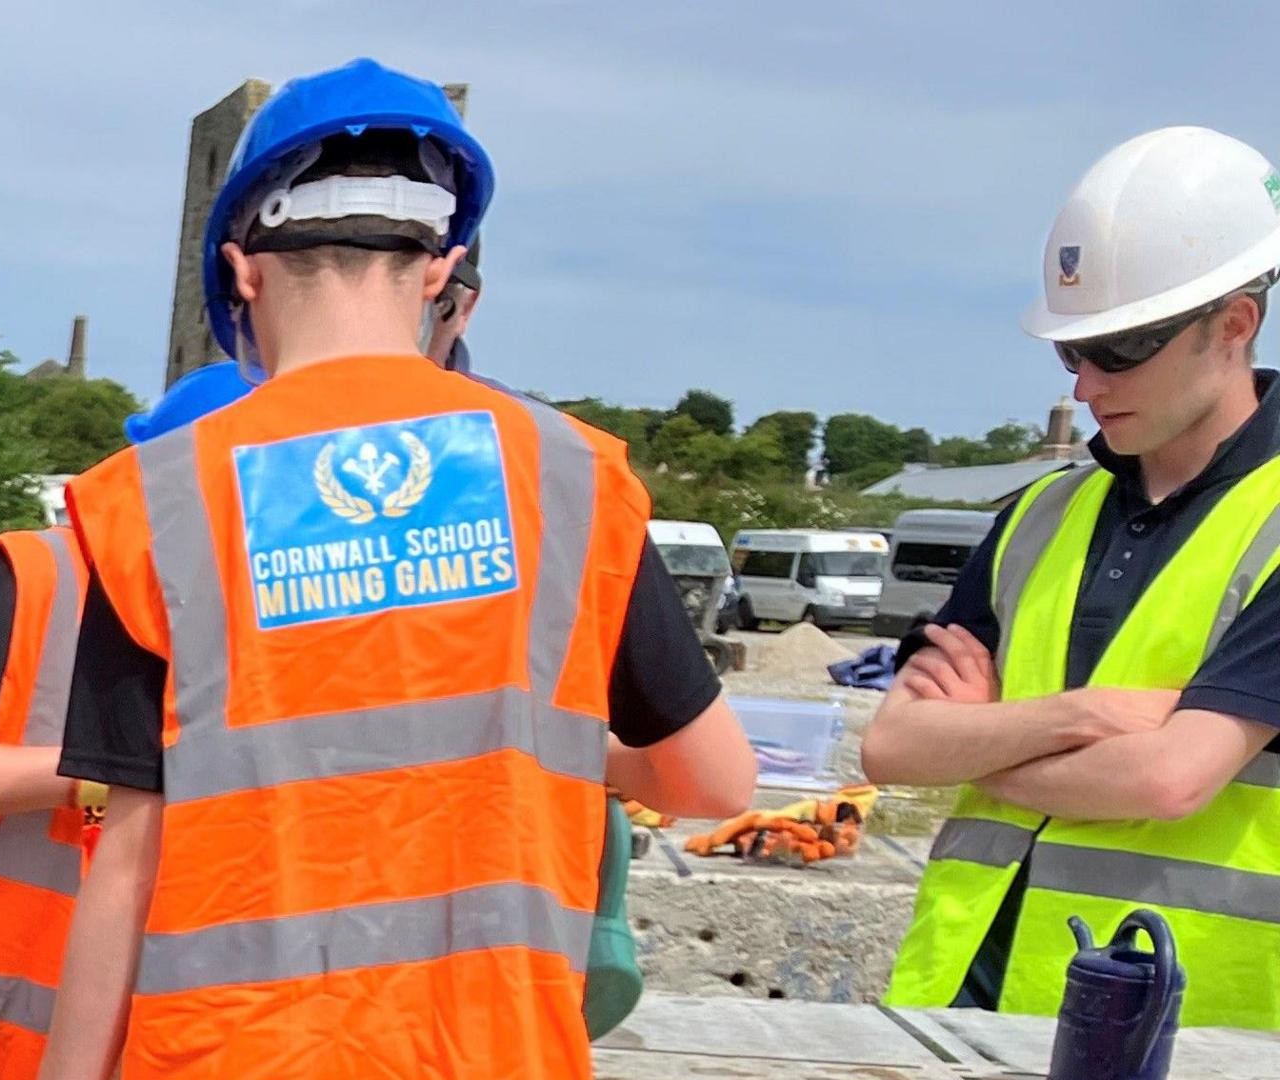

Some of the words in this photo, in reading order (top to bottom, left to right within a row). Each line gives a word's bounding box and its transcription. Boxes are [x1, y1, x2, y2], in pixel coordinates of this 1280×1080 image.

[253, 535, 397, 581] CORNWALL
[404, 517, 510, 556] SCHOOL
[257, 566, 386, 619] MINING
[395, 546, 513, 597] GAMES
